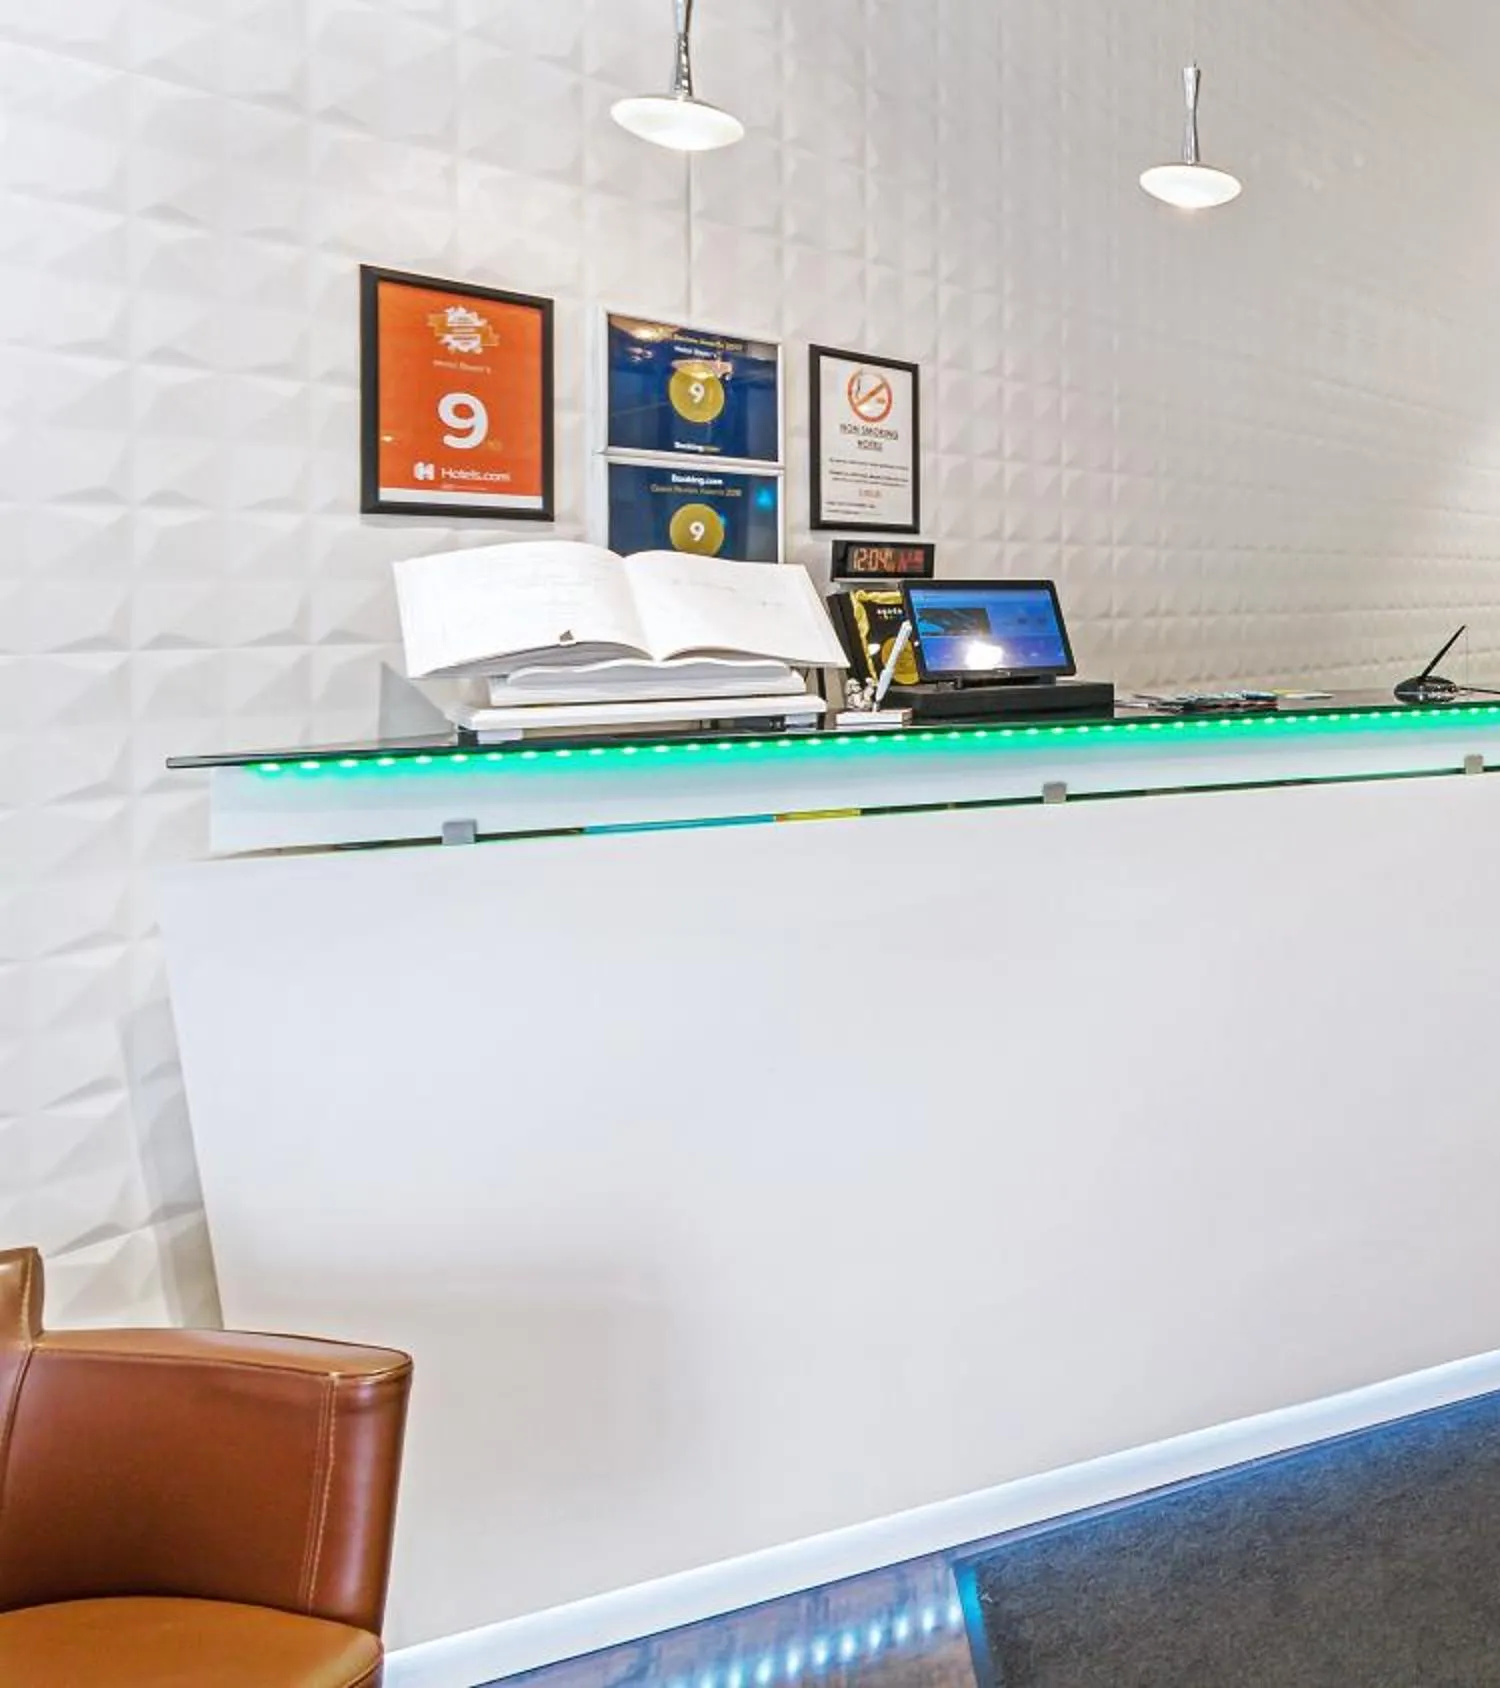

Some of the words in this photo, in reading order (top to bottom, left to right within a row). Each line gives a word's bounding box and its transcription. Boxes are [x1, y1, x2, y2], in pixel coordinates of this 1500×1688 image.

[689, 382, 705, 405] 9
[437, 391, 489, 449] 9
[860, 426, 899, 441] SMOKING
[441, 467, 511, 483] Hotels.com
[671, 473, 723, 486] Booking.com
[689, 521, 705, 542] 9
